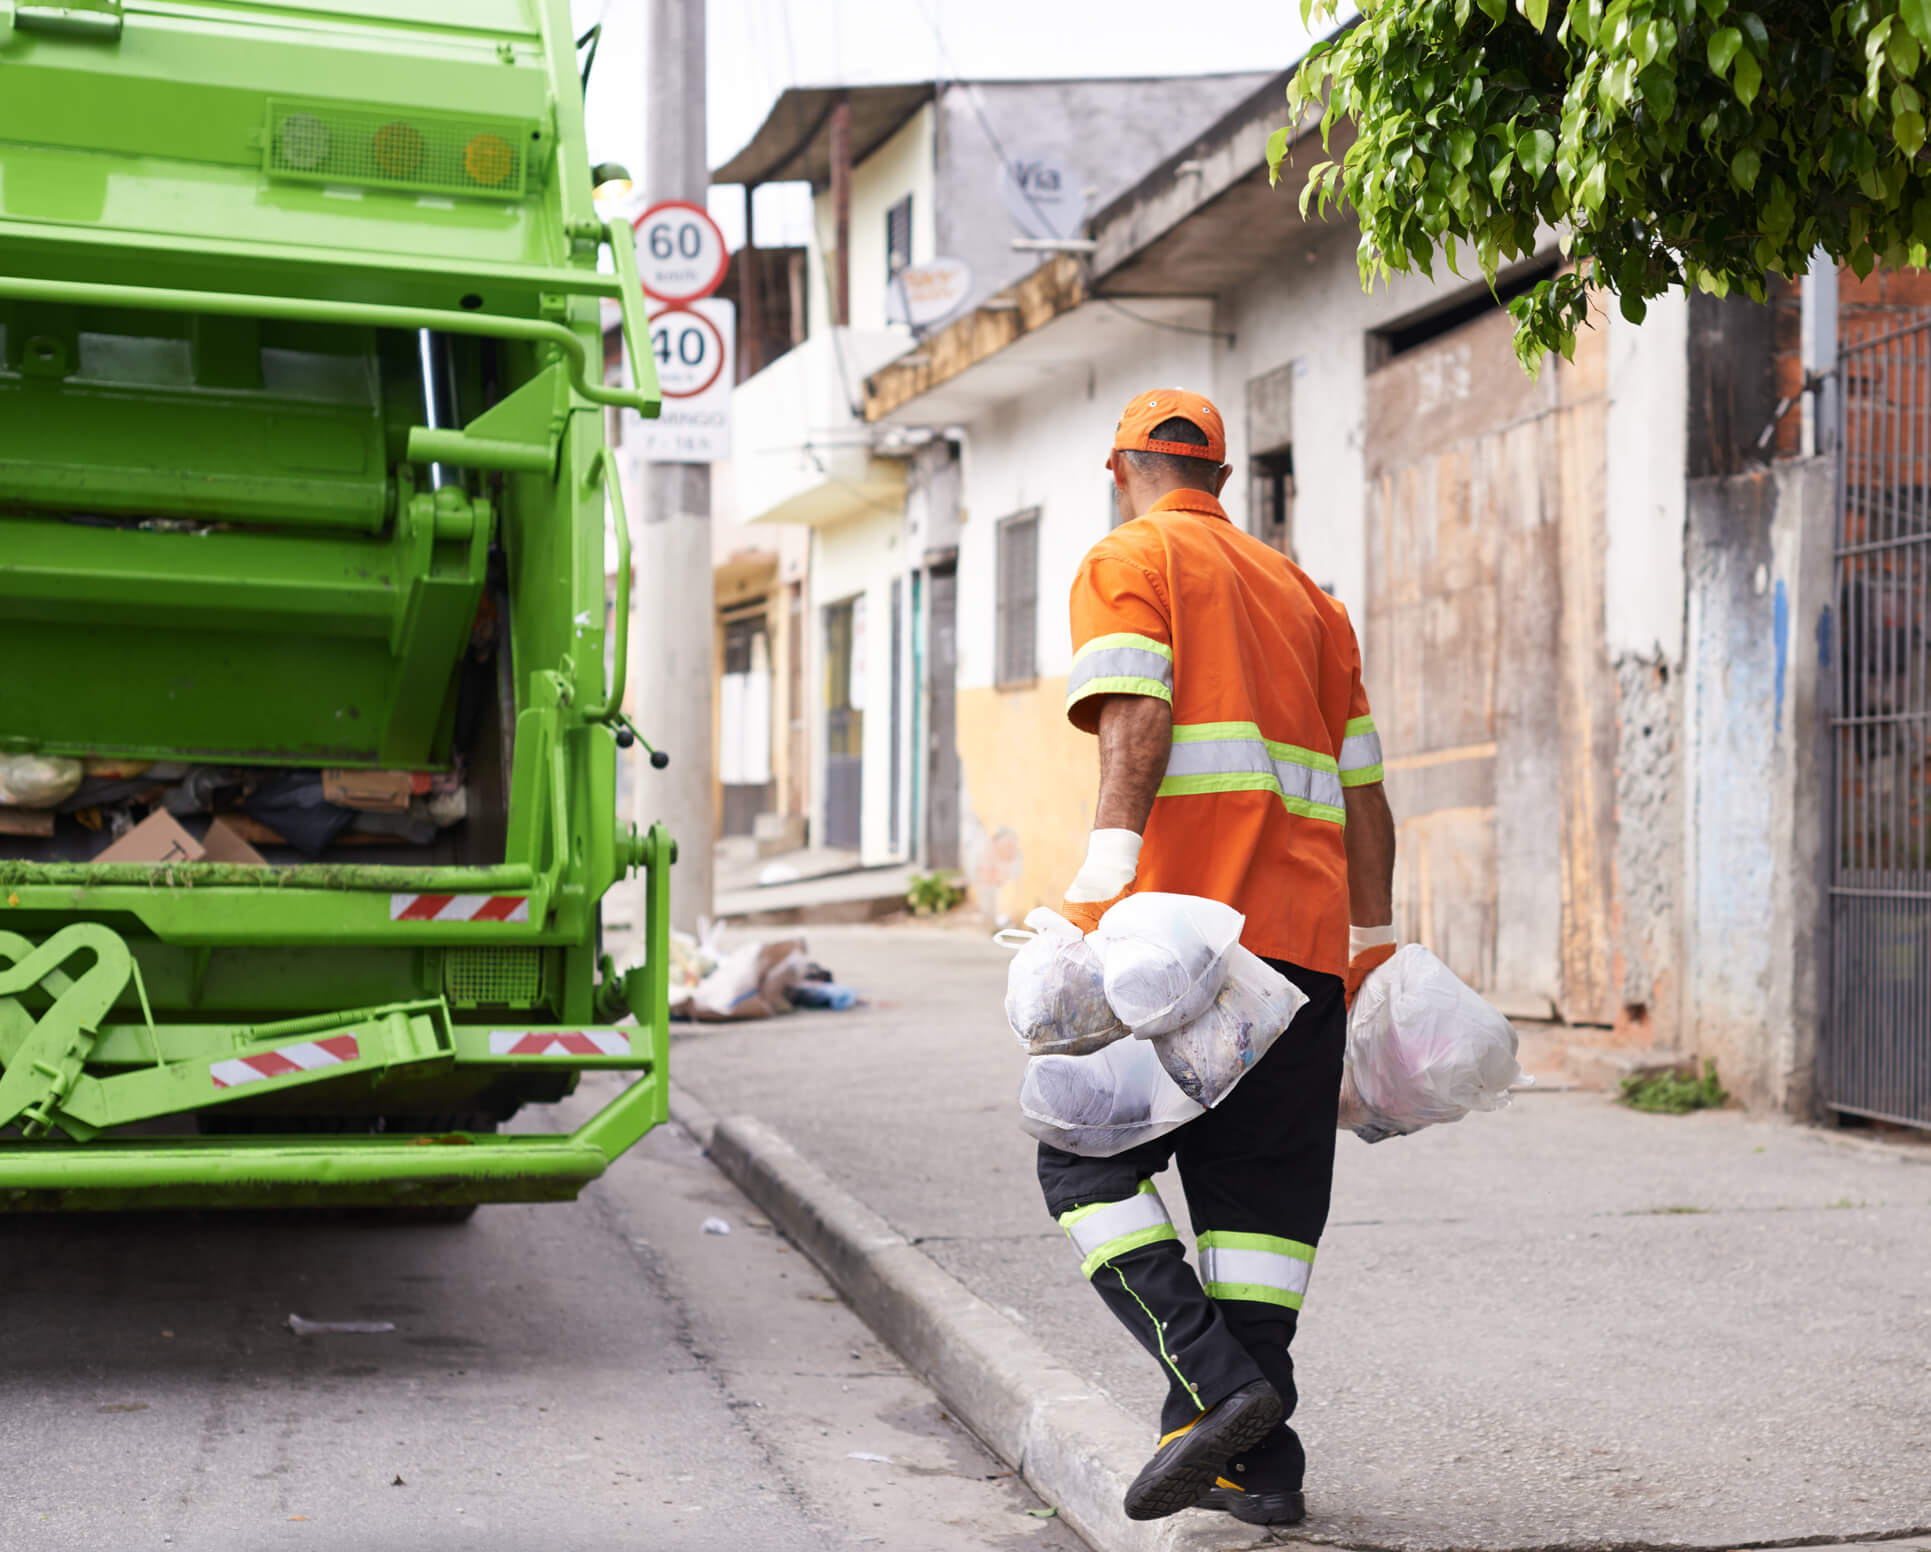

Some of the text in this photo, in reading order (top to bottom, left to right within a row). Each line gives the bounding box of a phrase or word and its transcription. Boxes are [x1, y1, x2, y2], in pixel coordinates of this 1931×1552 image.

[1014, 161, 1061, 190] Via
[649, 222, 702, 260] 60
[651, 327, 705, 366] 40
